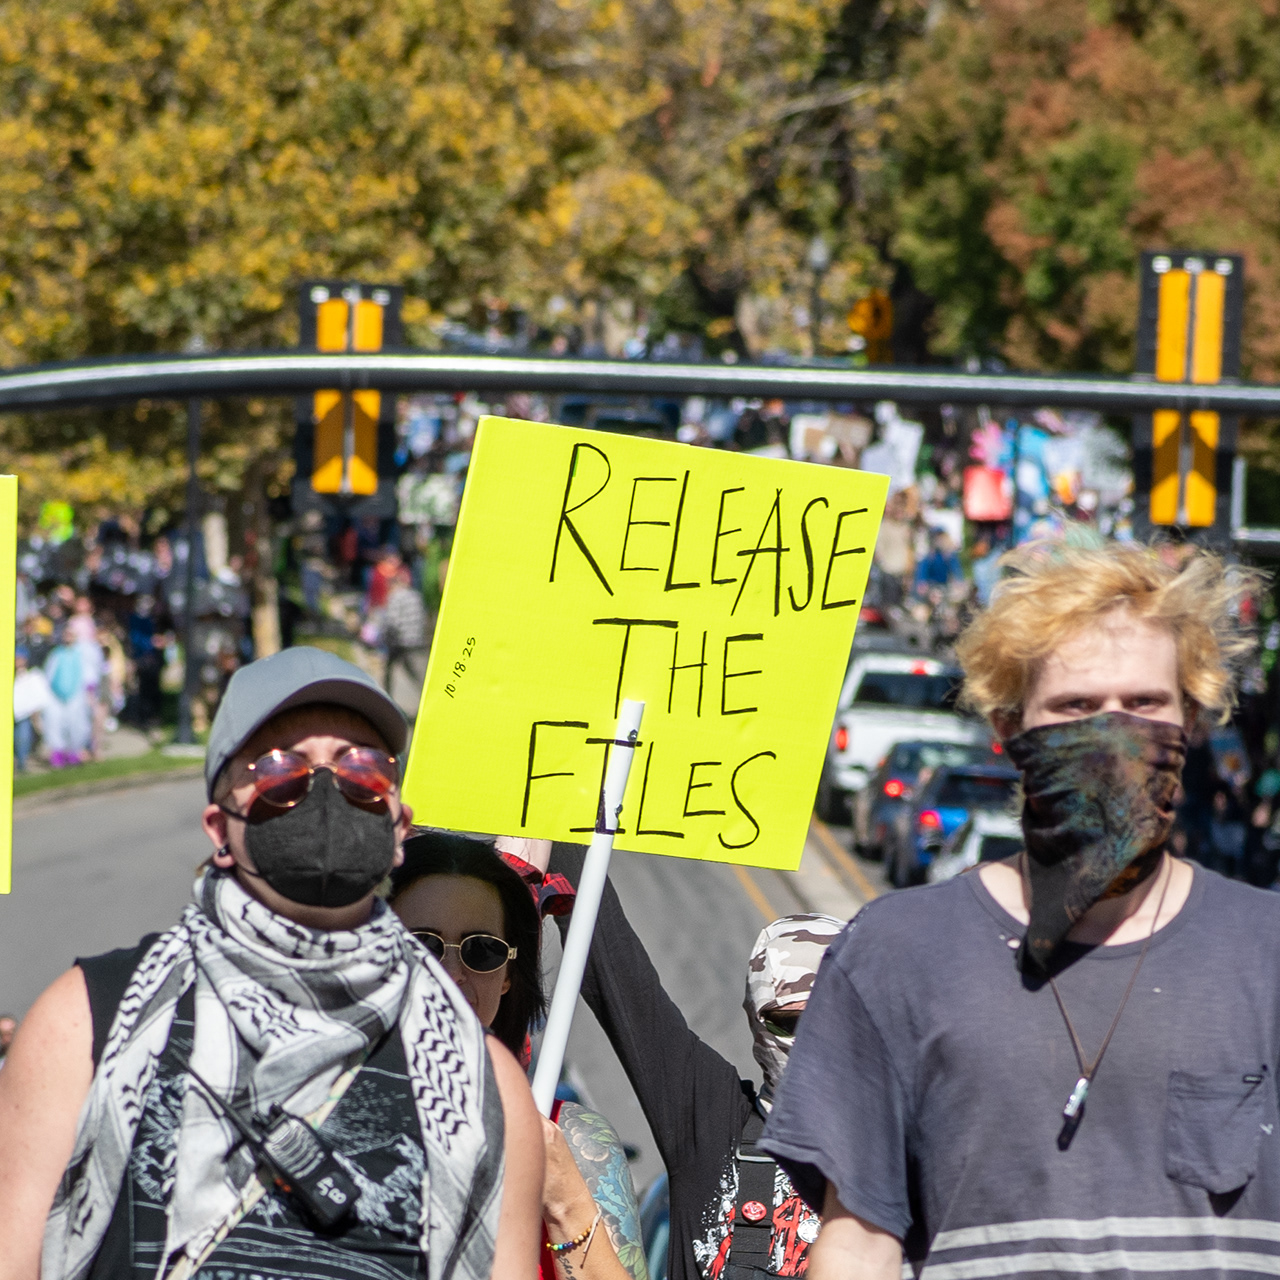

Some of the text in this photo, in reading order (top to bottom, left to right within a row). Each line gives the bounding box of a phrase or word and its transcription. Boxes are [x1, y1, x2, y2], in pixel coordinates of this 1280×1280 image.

[549, 442, 868, 616] RELEASE
[592, 617, 764, 719] THE
[520, 720, 777, 849] FILES
